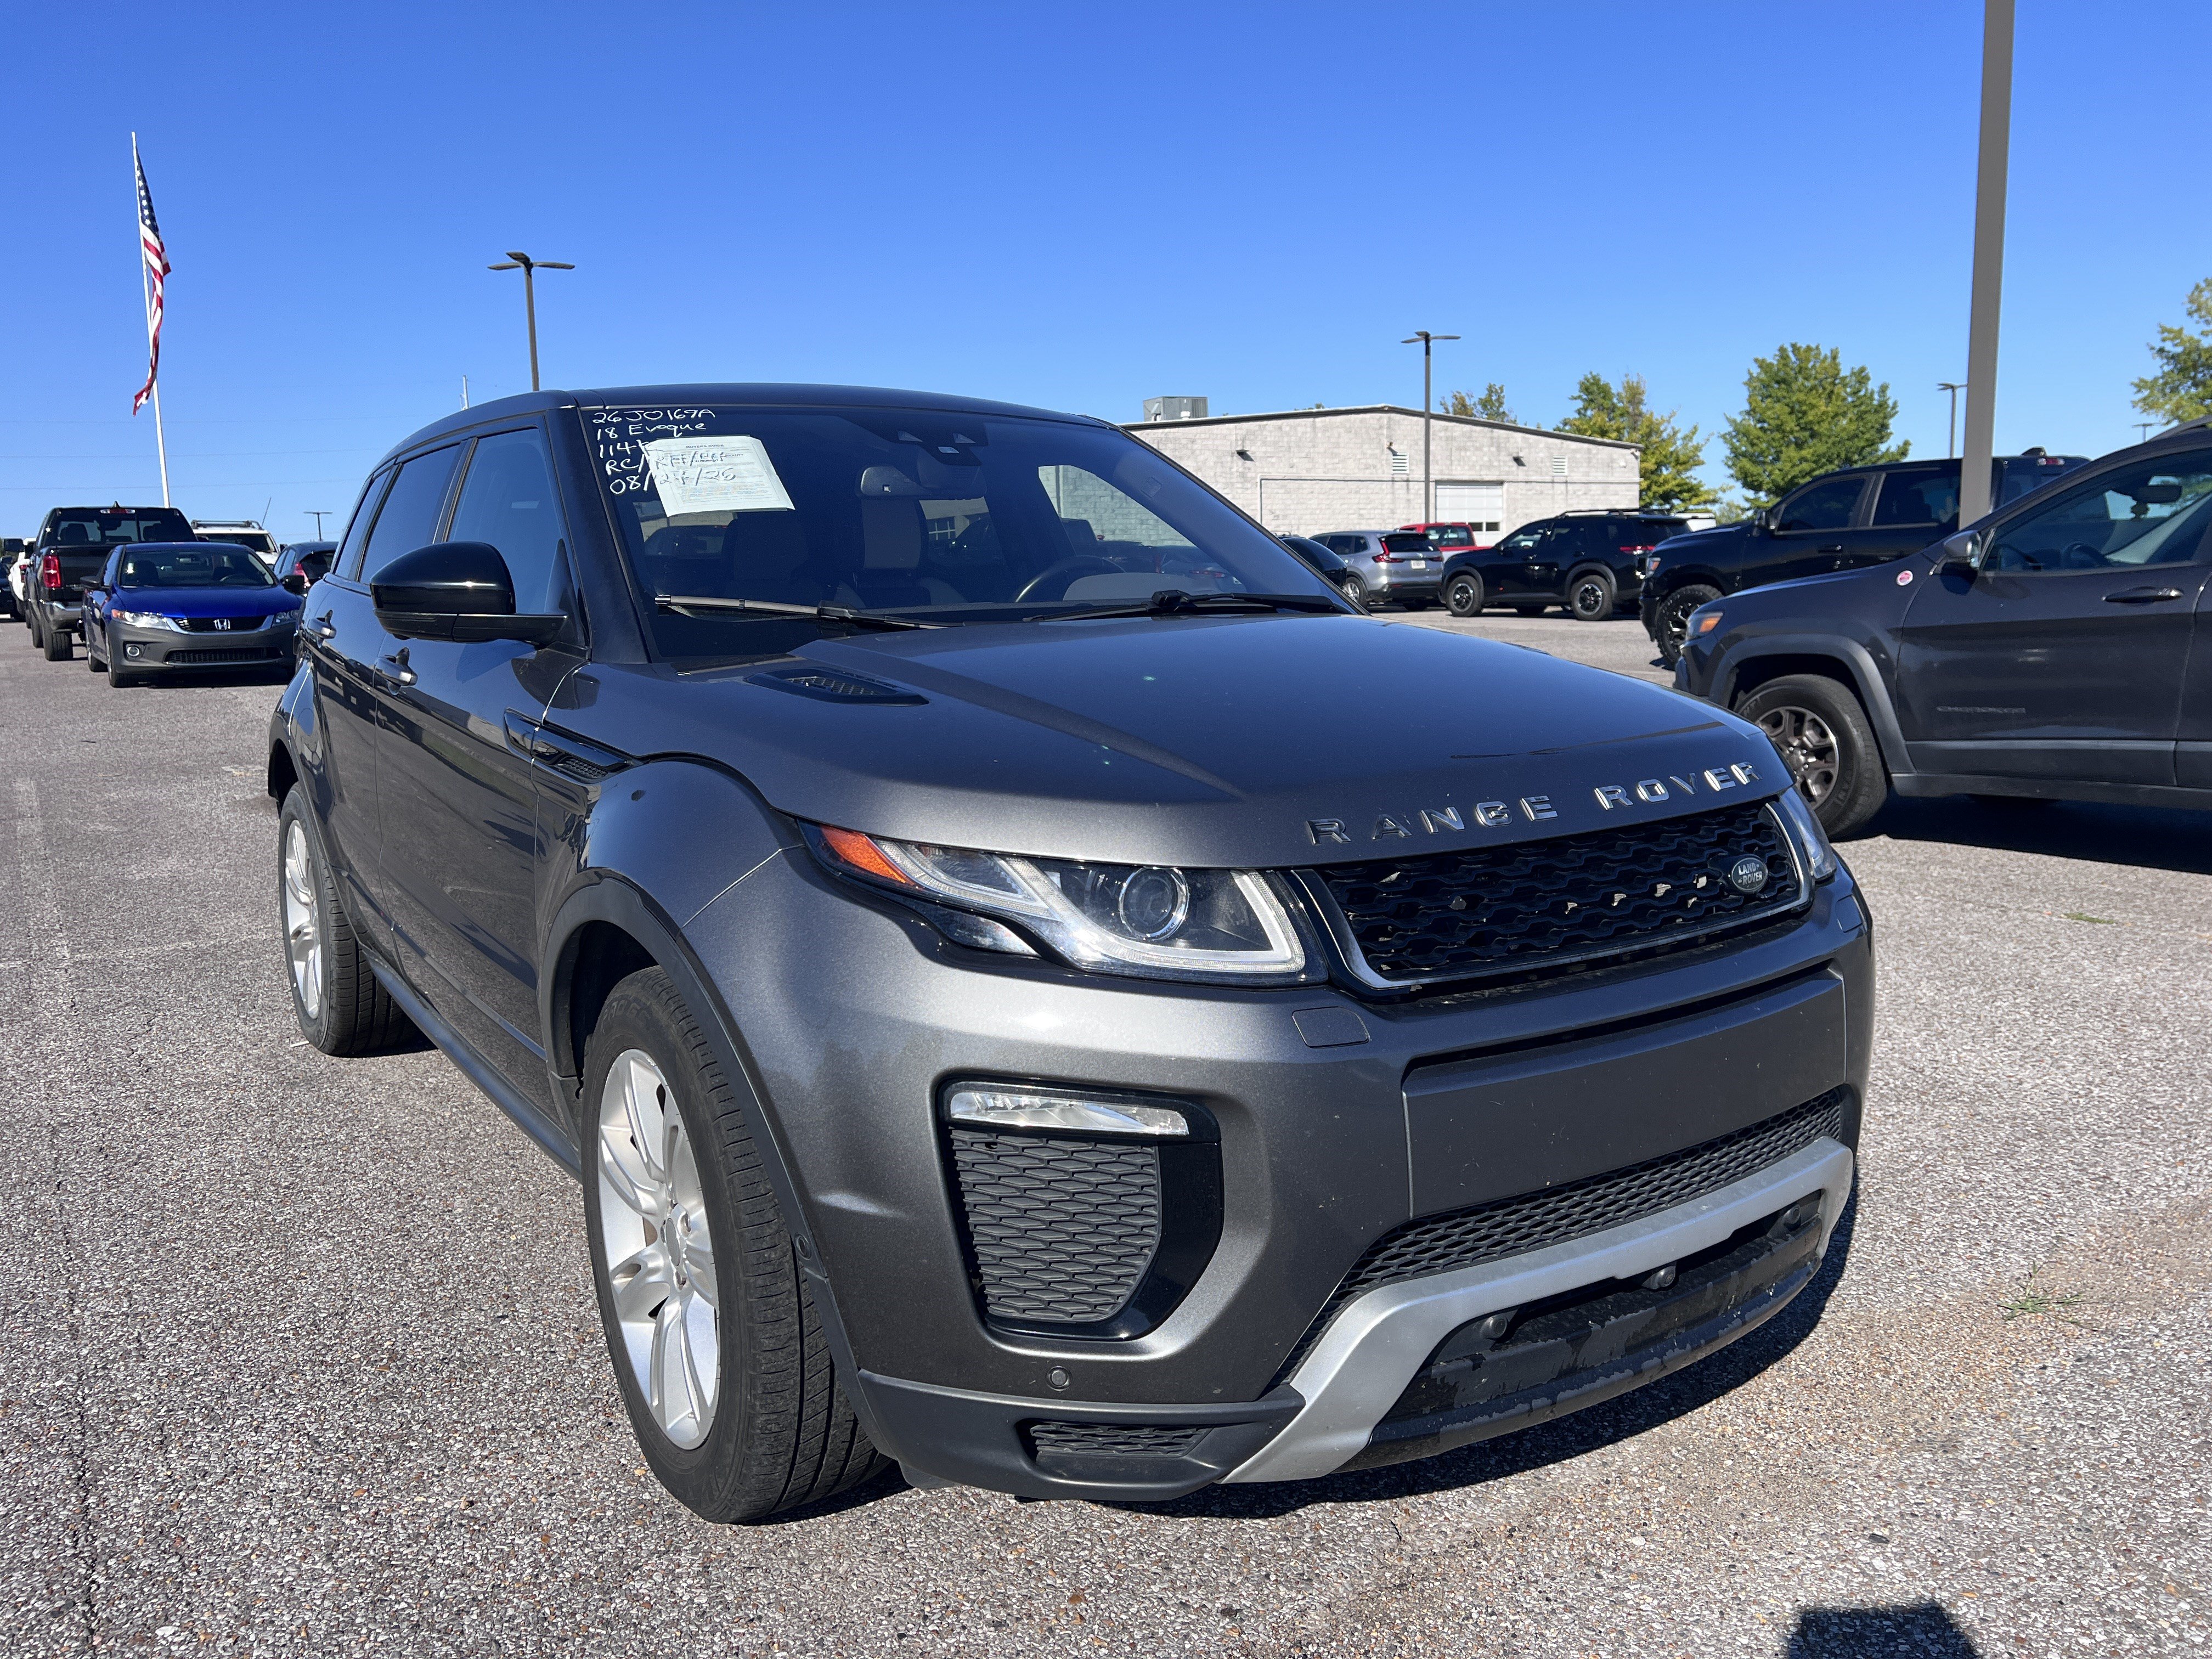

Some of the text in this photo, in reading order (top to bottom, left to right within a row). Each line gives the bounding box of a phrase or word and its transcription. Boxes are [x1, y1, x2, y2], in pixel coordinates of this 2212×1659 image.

[597, 423, 707, 441] 18 Evoque
[1306, 760, 1763, 845] RANGE ROVER
[1738, 862, 1756, 876] LAND
[1742, 871, 1763, 885] ROVER
